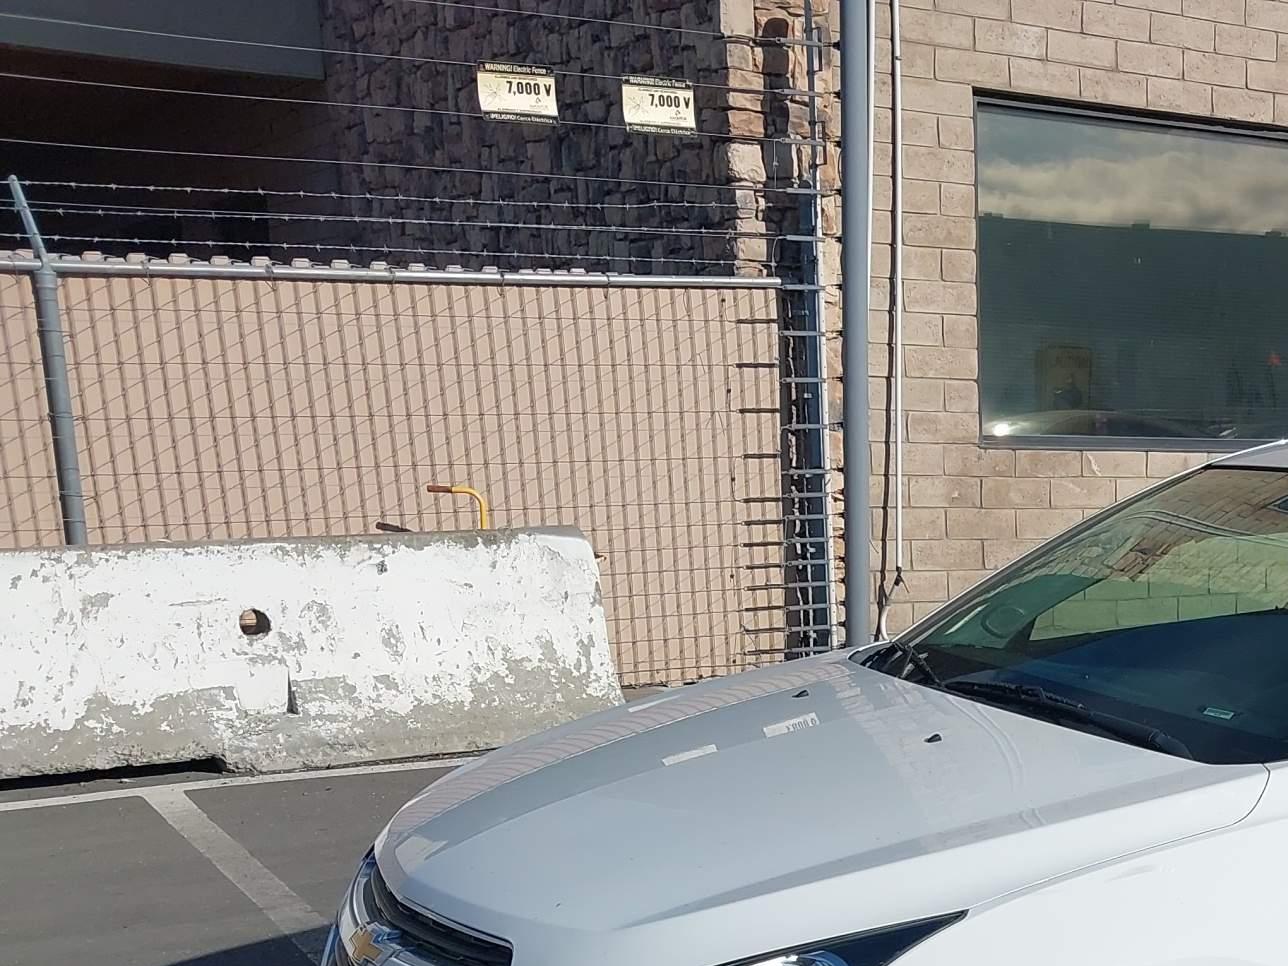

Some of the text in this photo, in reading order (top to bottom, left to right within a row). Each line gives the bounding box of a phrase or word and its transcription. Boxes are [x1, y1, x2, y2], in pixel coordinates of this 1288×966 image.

[484, 63, 547, 75] WARNING! Electric Fence
[506, 81, 552, 96] 7,000 V
[648, 94, 691, 109] 7,000 V
